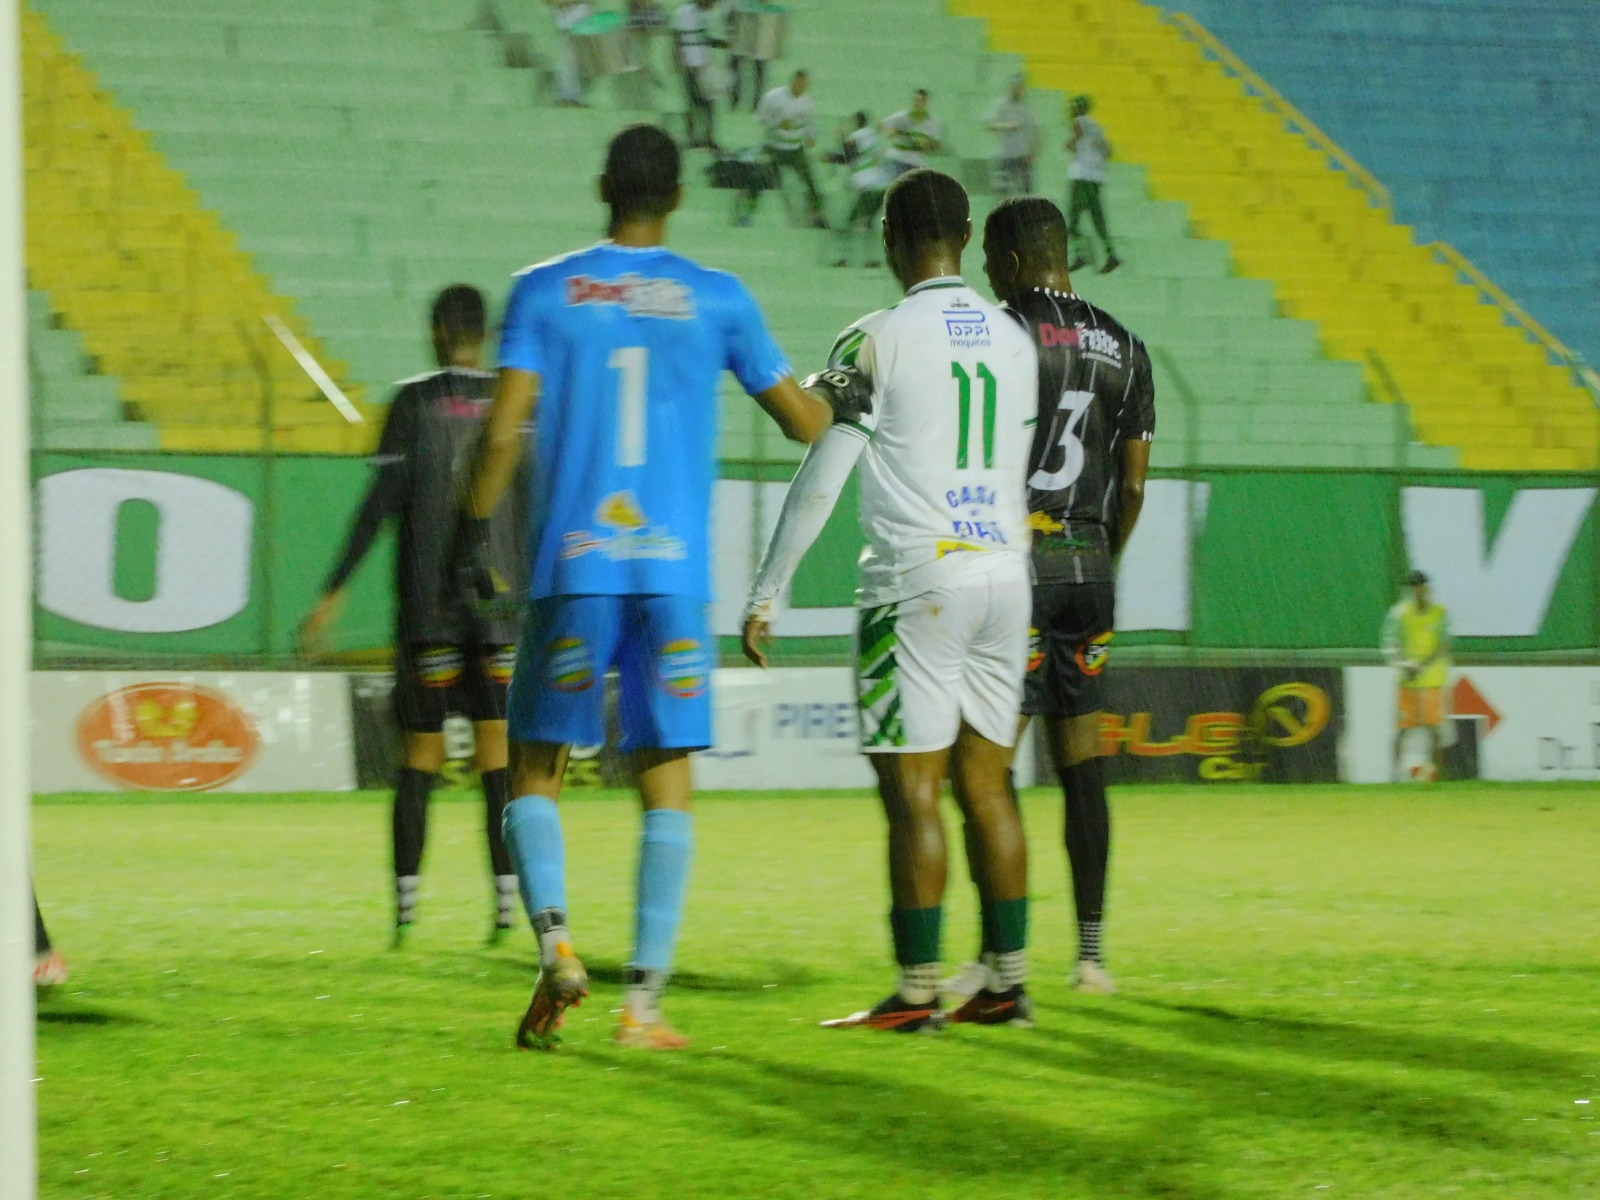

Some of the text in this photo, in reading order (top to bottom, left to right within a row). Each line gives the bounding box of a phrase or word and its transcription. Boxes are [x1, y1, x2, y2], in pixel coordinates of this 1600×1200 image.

[606, 347, 649, 467] 1
[951, 361, 997, 469] 11
[1028, 390, 1095, 490] 3
